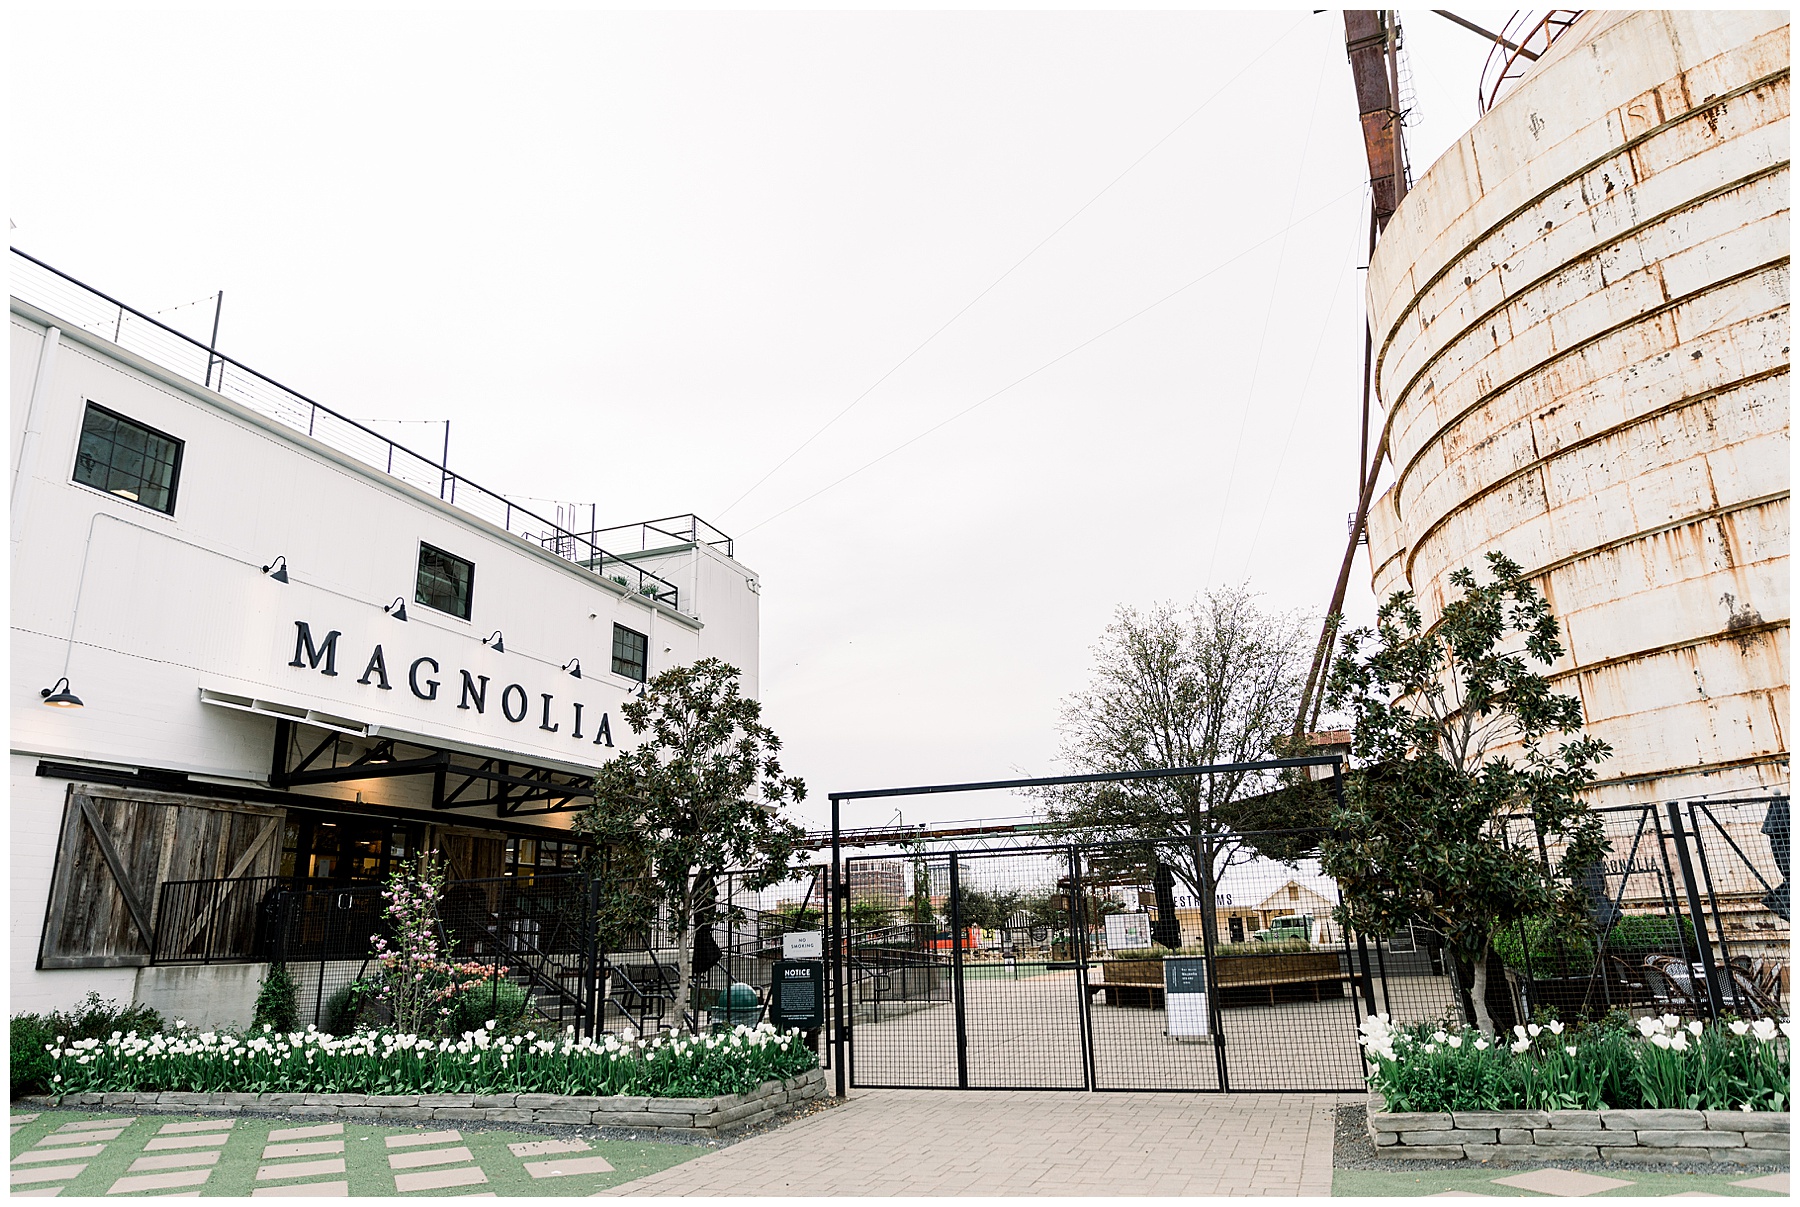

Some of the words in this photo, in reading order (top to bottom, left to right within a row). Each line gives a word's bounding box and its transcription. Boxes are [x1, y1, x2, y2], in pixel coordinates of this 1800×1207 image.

[288, 620, 615, 747] MAGNOLIA
[1602, 857, 1660, 873] AGNOLIA
[1173, 893, 1233, 907] ESTRMS
[784, 968, 811, 976] NOTICE
